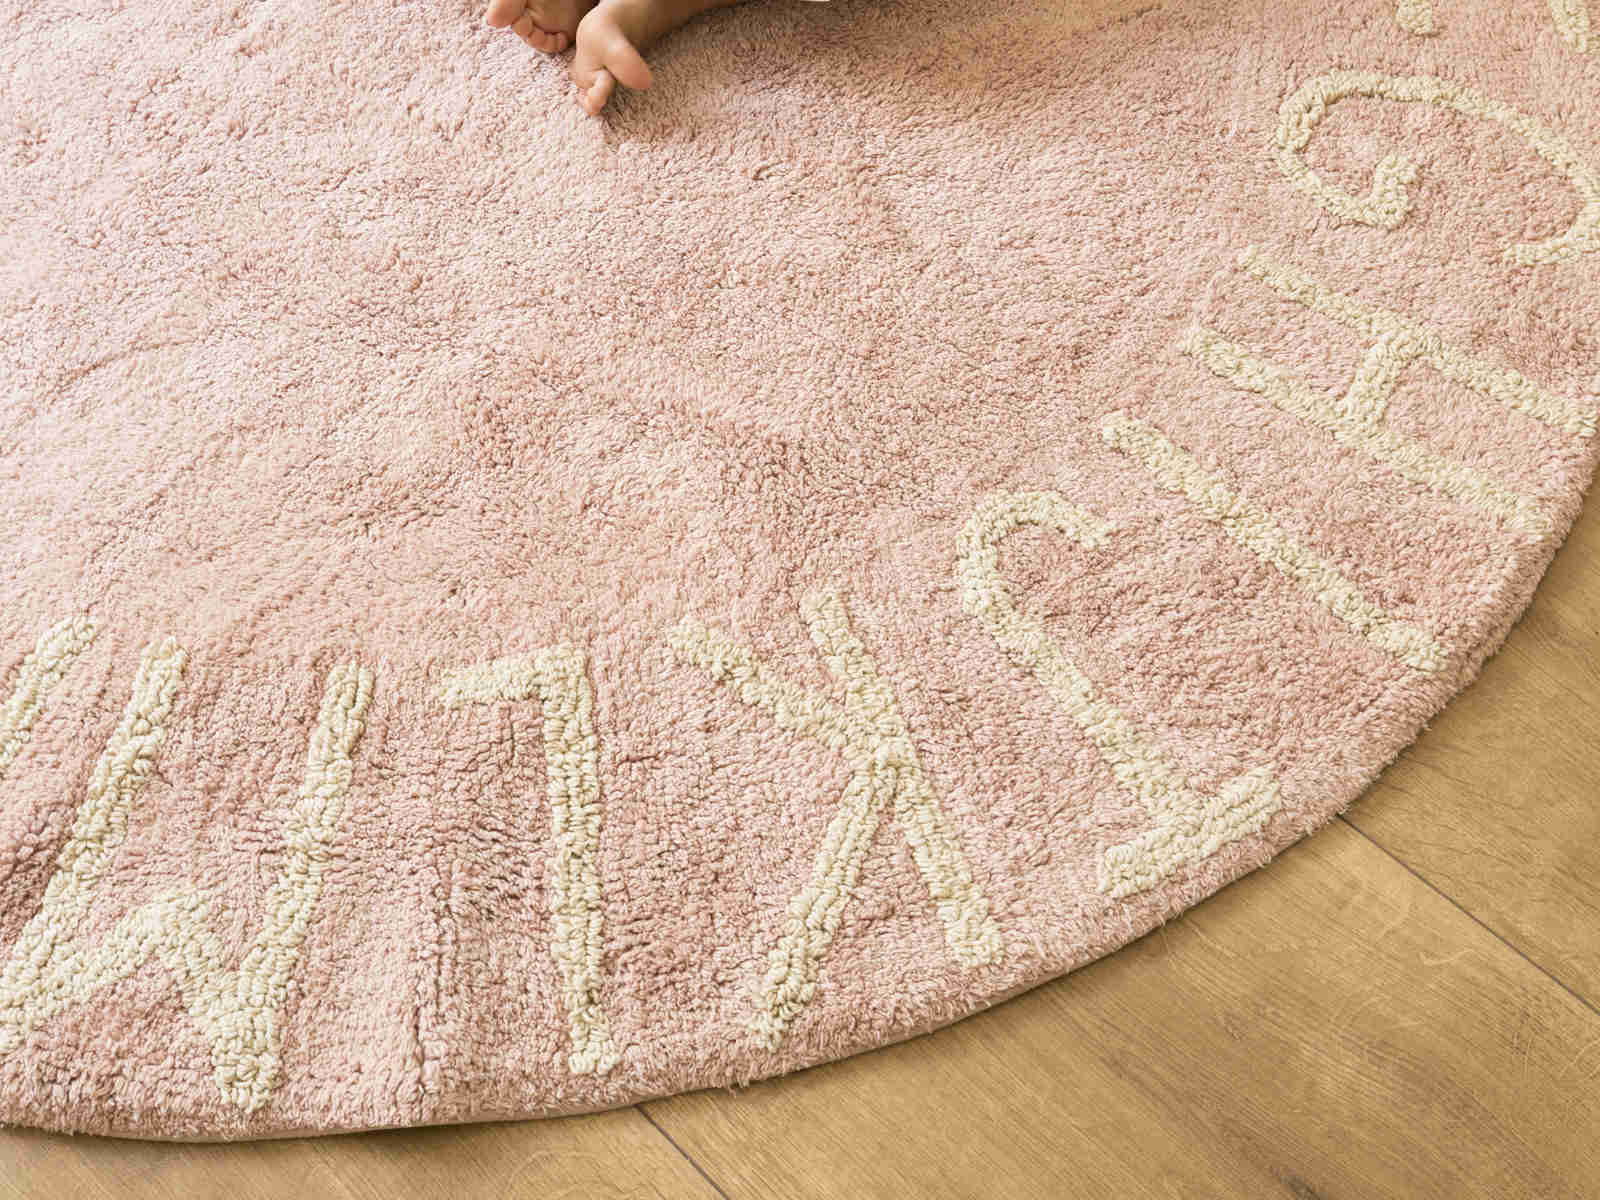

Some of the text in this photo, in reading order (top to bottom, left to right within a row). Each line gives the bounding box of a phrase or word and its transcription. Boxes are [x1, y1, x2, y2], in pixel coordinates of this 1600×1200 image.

[1273, 71, 1600, 266] G
[1100, 410, 1448, 672] I
[1175, 244, 1600, 540] H
[0, 636, 375, 1113] M
[437, 642, 622, 1075] L
[665, 590, 1005, 1055] K
[955, 488, 1282, 898] J
